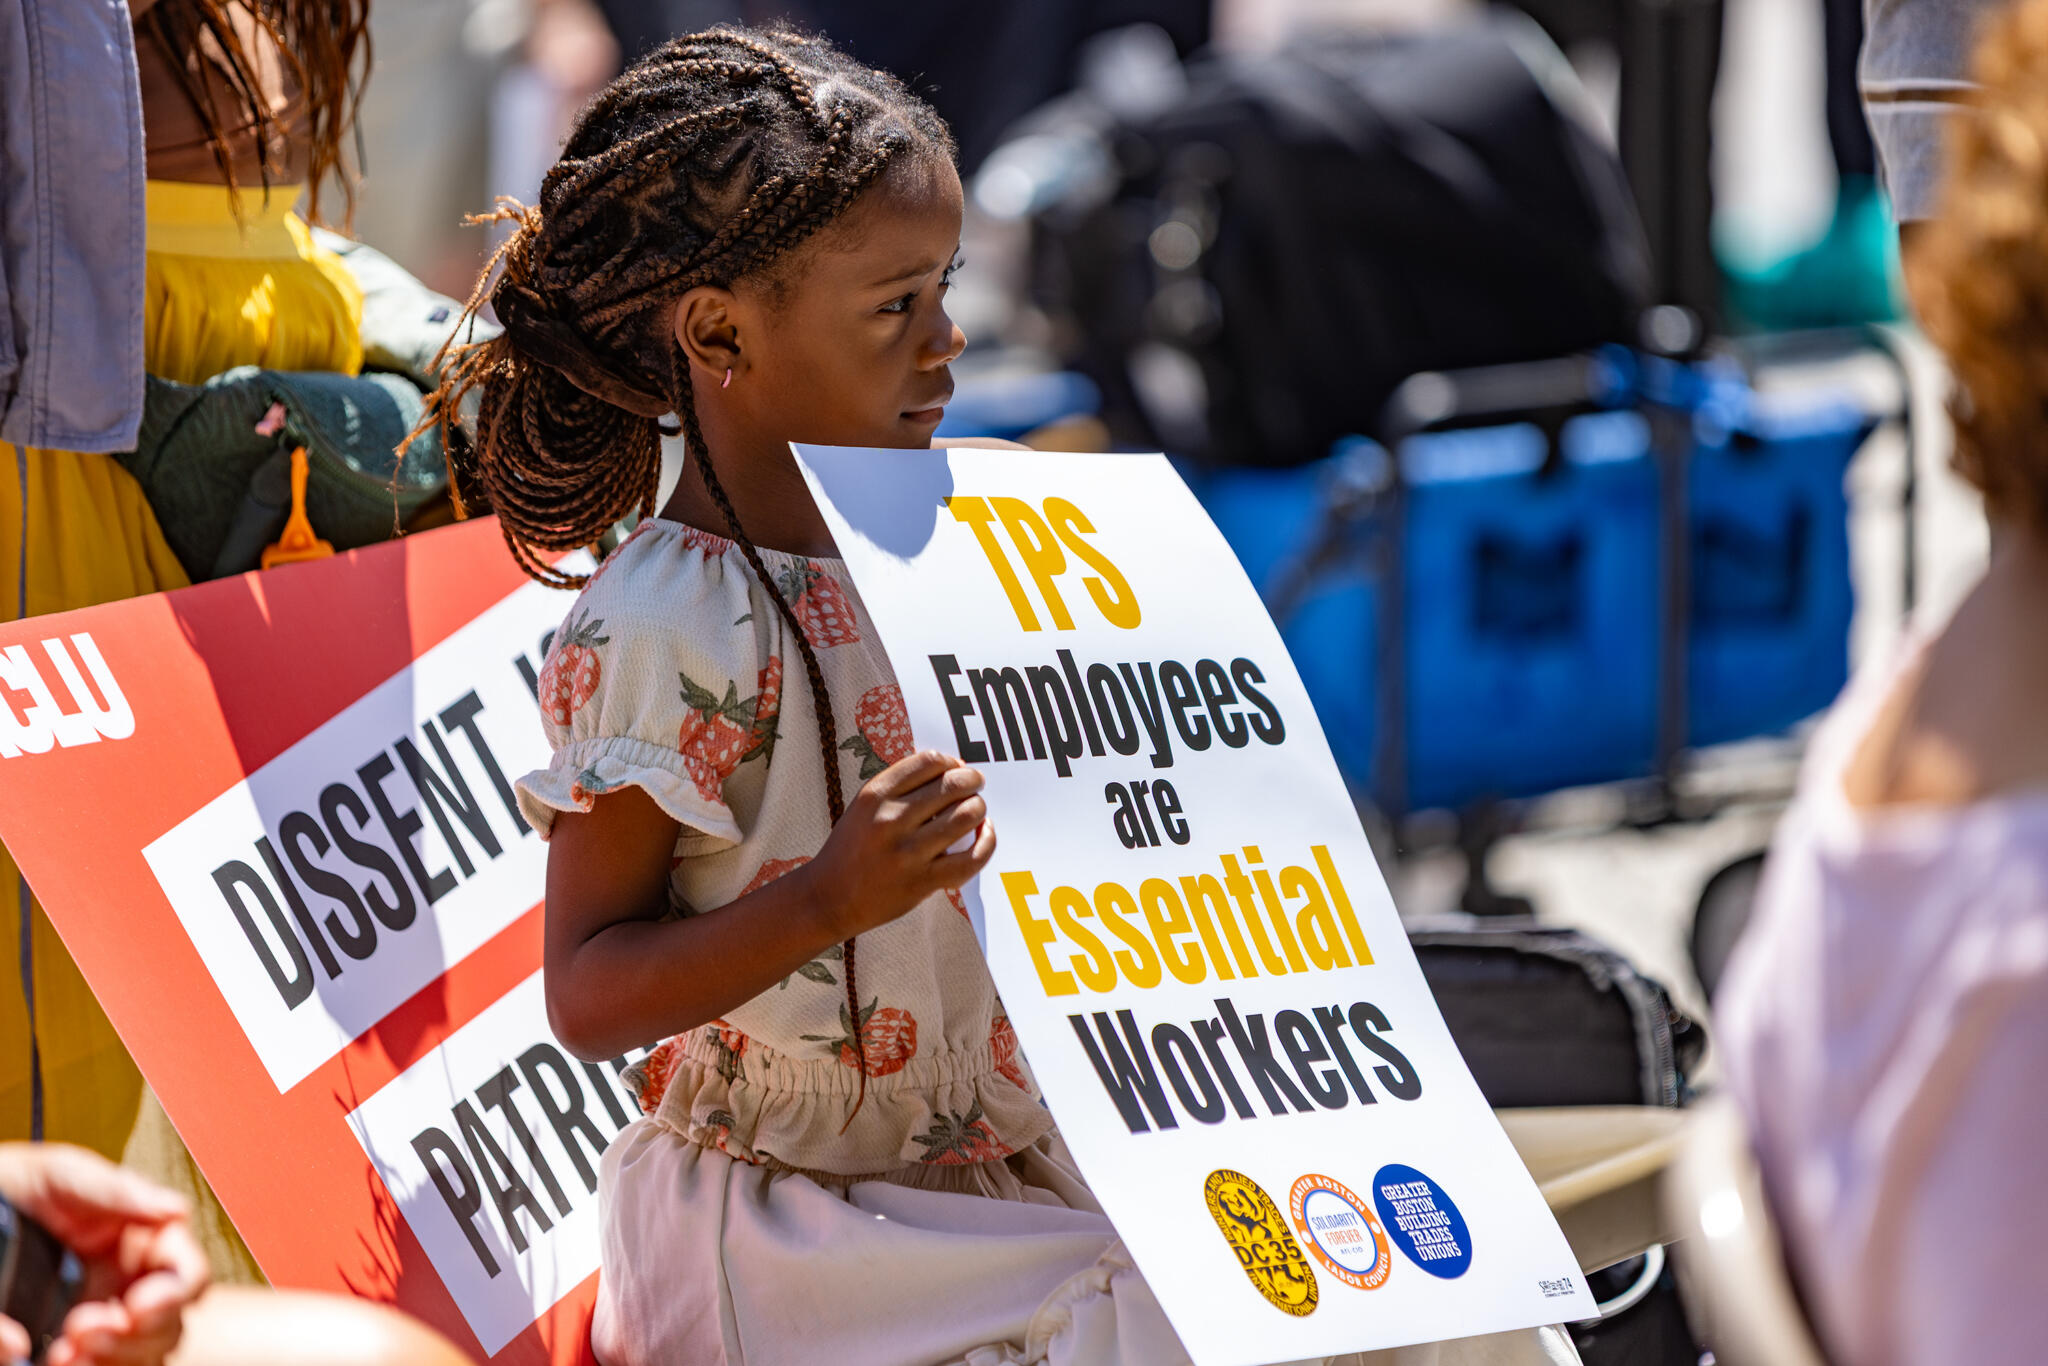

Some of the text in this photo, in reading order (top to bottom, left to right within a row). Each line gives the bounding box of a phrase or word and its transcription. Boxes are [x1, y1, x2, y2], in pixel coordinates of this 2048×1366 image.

[943, 497, 1142, 632] TPS
[0, 632, 136, 759] CLU
[928, 649, 1286, 778] Employees
[1104, 778, 1191, 850] are
[211, 690, 533, 1011] DISSENT
[999, 844, 1375, 997] Essential
[1067, 998, 1422, 1133] Workers
[1208, 1172, 1223, 1193] AND
[1223, 1171, 1256, 1192] ALLIED
[1258, 1191, 1289, 1235] TRADES
[1292, 1176, 1365, 1220] GREATER BOSTON
[1381, 1181, 1433, 1201] GREATER
[1391, 1196, 1438, 1216] BOSTON
[1311, 1212, 1359, 1231] SOLIDARITY
[1325, 1228, 1364, 1247] FOREVER
[1394, 1210, 1452, 1232] BUILDING
[1407, 1226, 1455, 1246] TRADES
[1233, 1238, 1301, 1265] DC 35
[1324, 1252, 1389, 1287] LABOR COUNCIL
[1415, 1241, 1462, 1261] UNIONS
[1302, 1266, 1317, 1303] UNION
